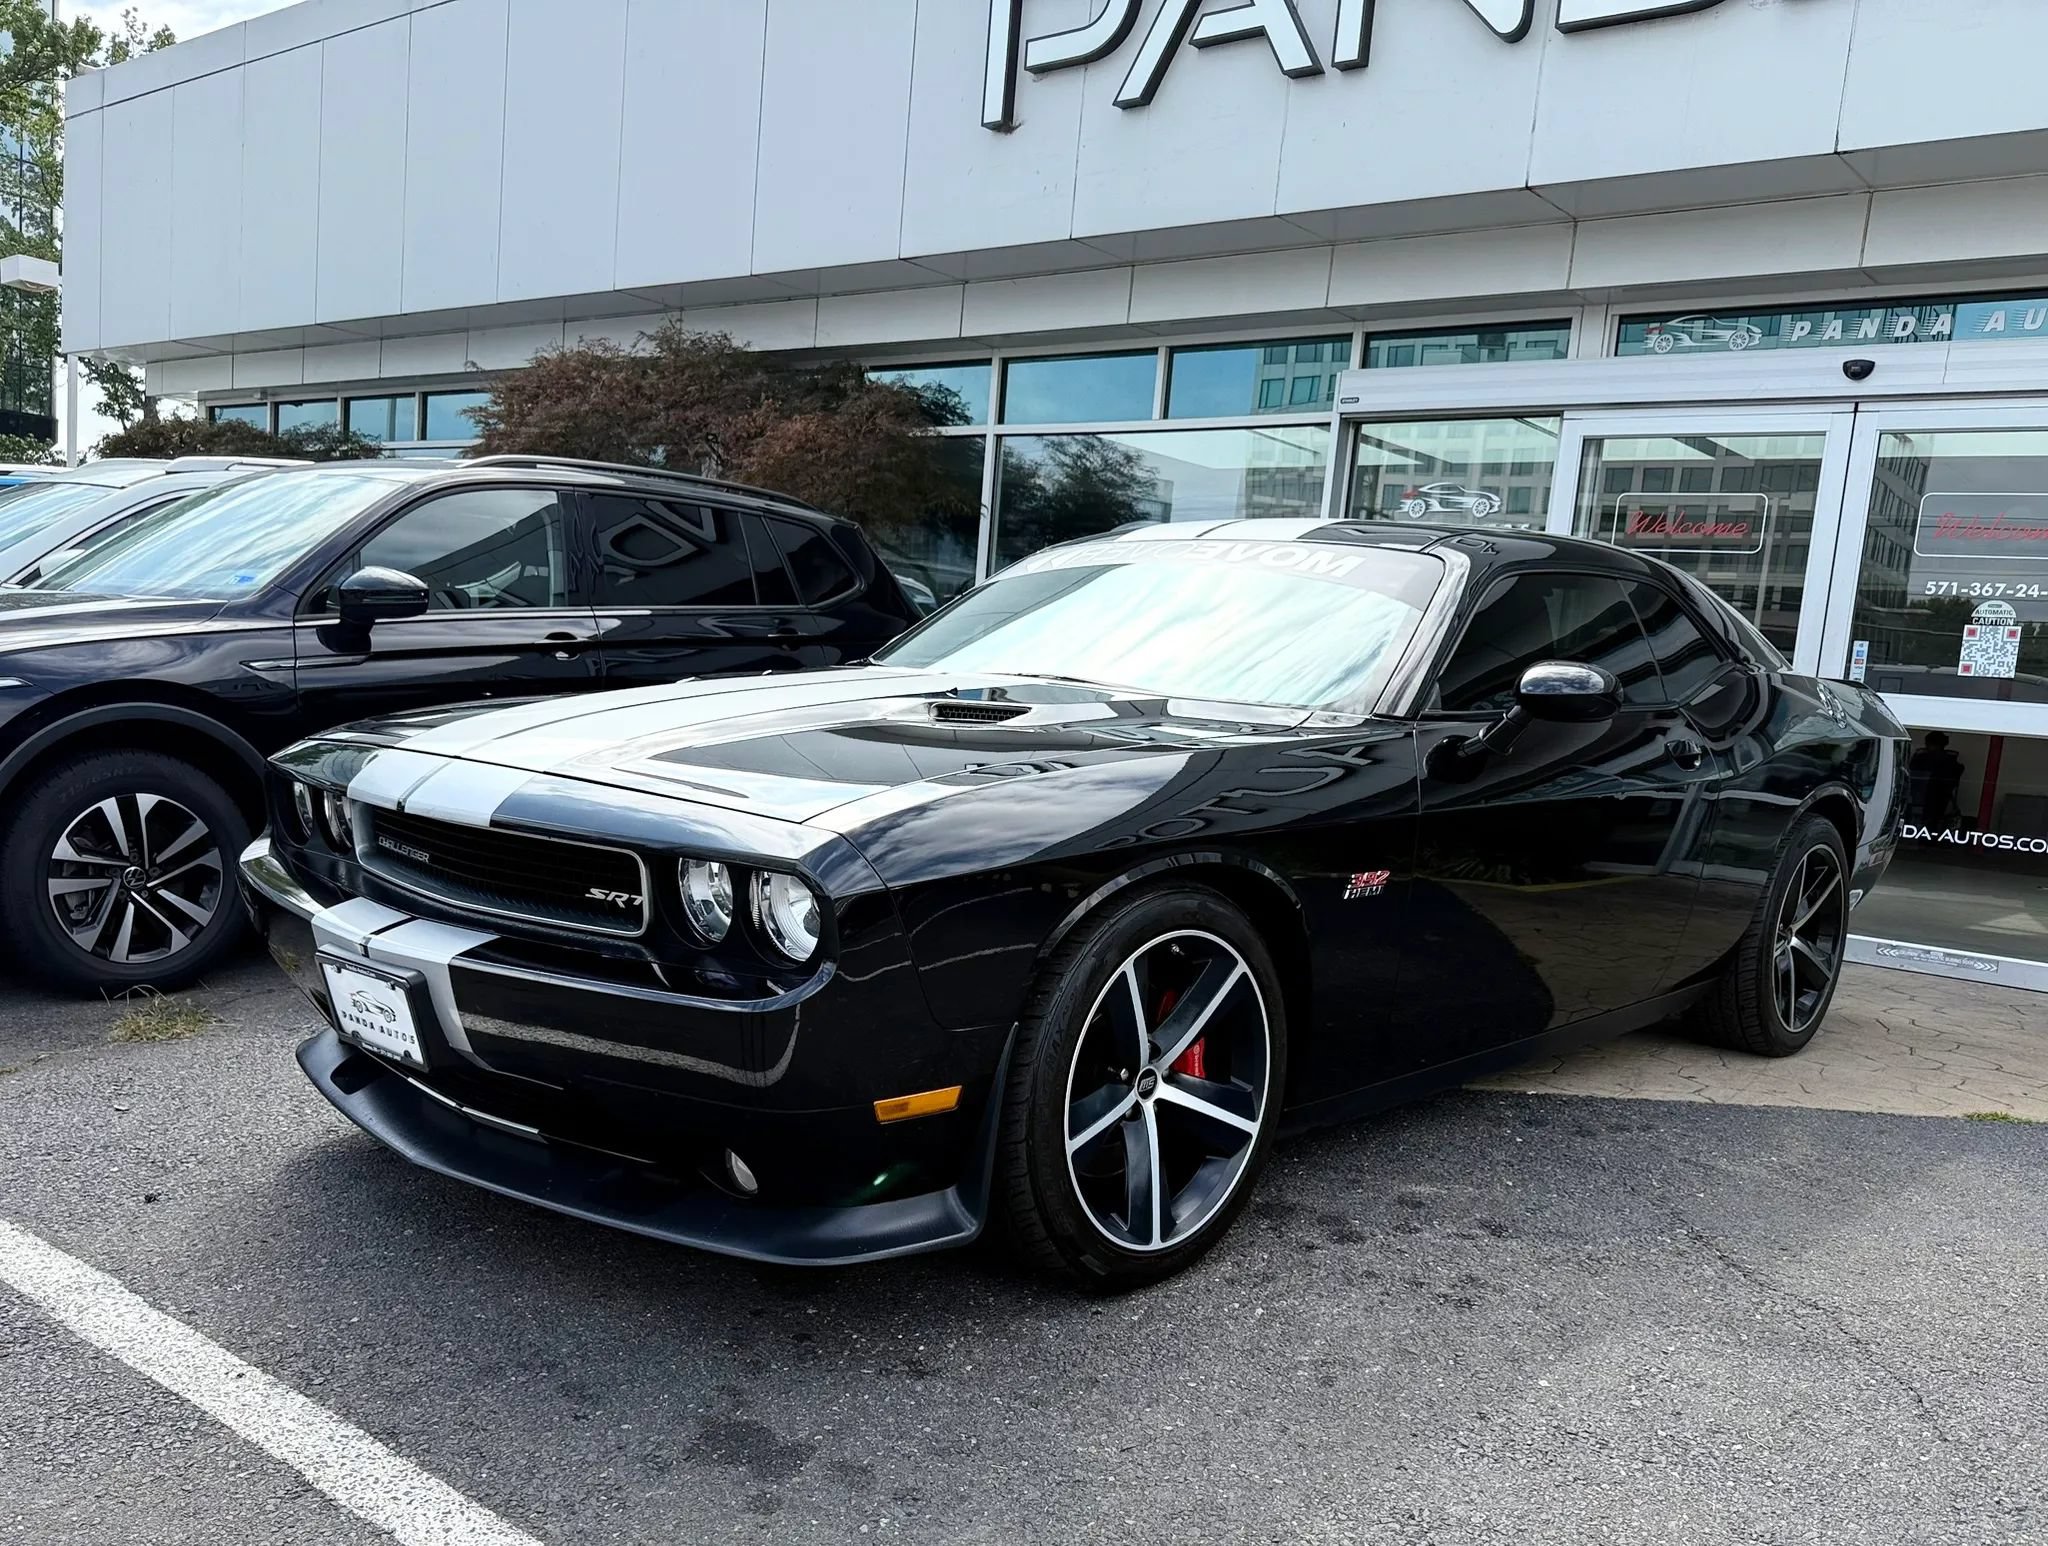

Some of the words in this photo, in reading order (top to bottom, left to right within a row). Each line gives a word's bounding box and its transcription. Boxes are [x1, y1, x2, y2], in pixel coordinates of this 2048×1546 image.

[980, 0, 1722, 130] PA
[1788, 312, 1951, 342] PANDA
[1981, 306, 2048, 333] AU
[1626, 510, 1749, 536] Welcome
[1972, 617, 2014, 626] CAUTION
[1975, 608, 2013, 616] AUTOMATIC
[379, 836, 430, 864] CHALLENGER
[1900, 822, 2048, 853] DA-AUTOS.CO
[585, 888, 643, 908] SRT
[341, 1010, 375, 1031] PANDA
[379, 1025, 416, 1044] AUTOS
